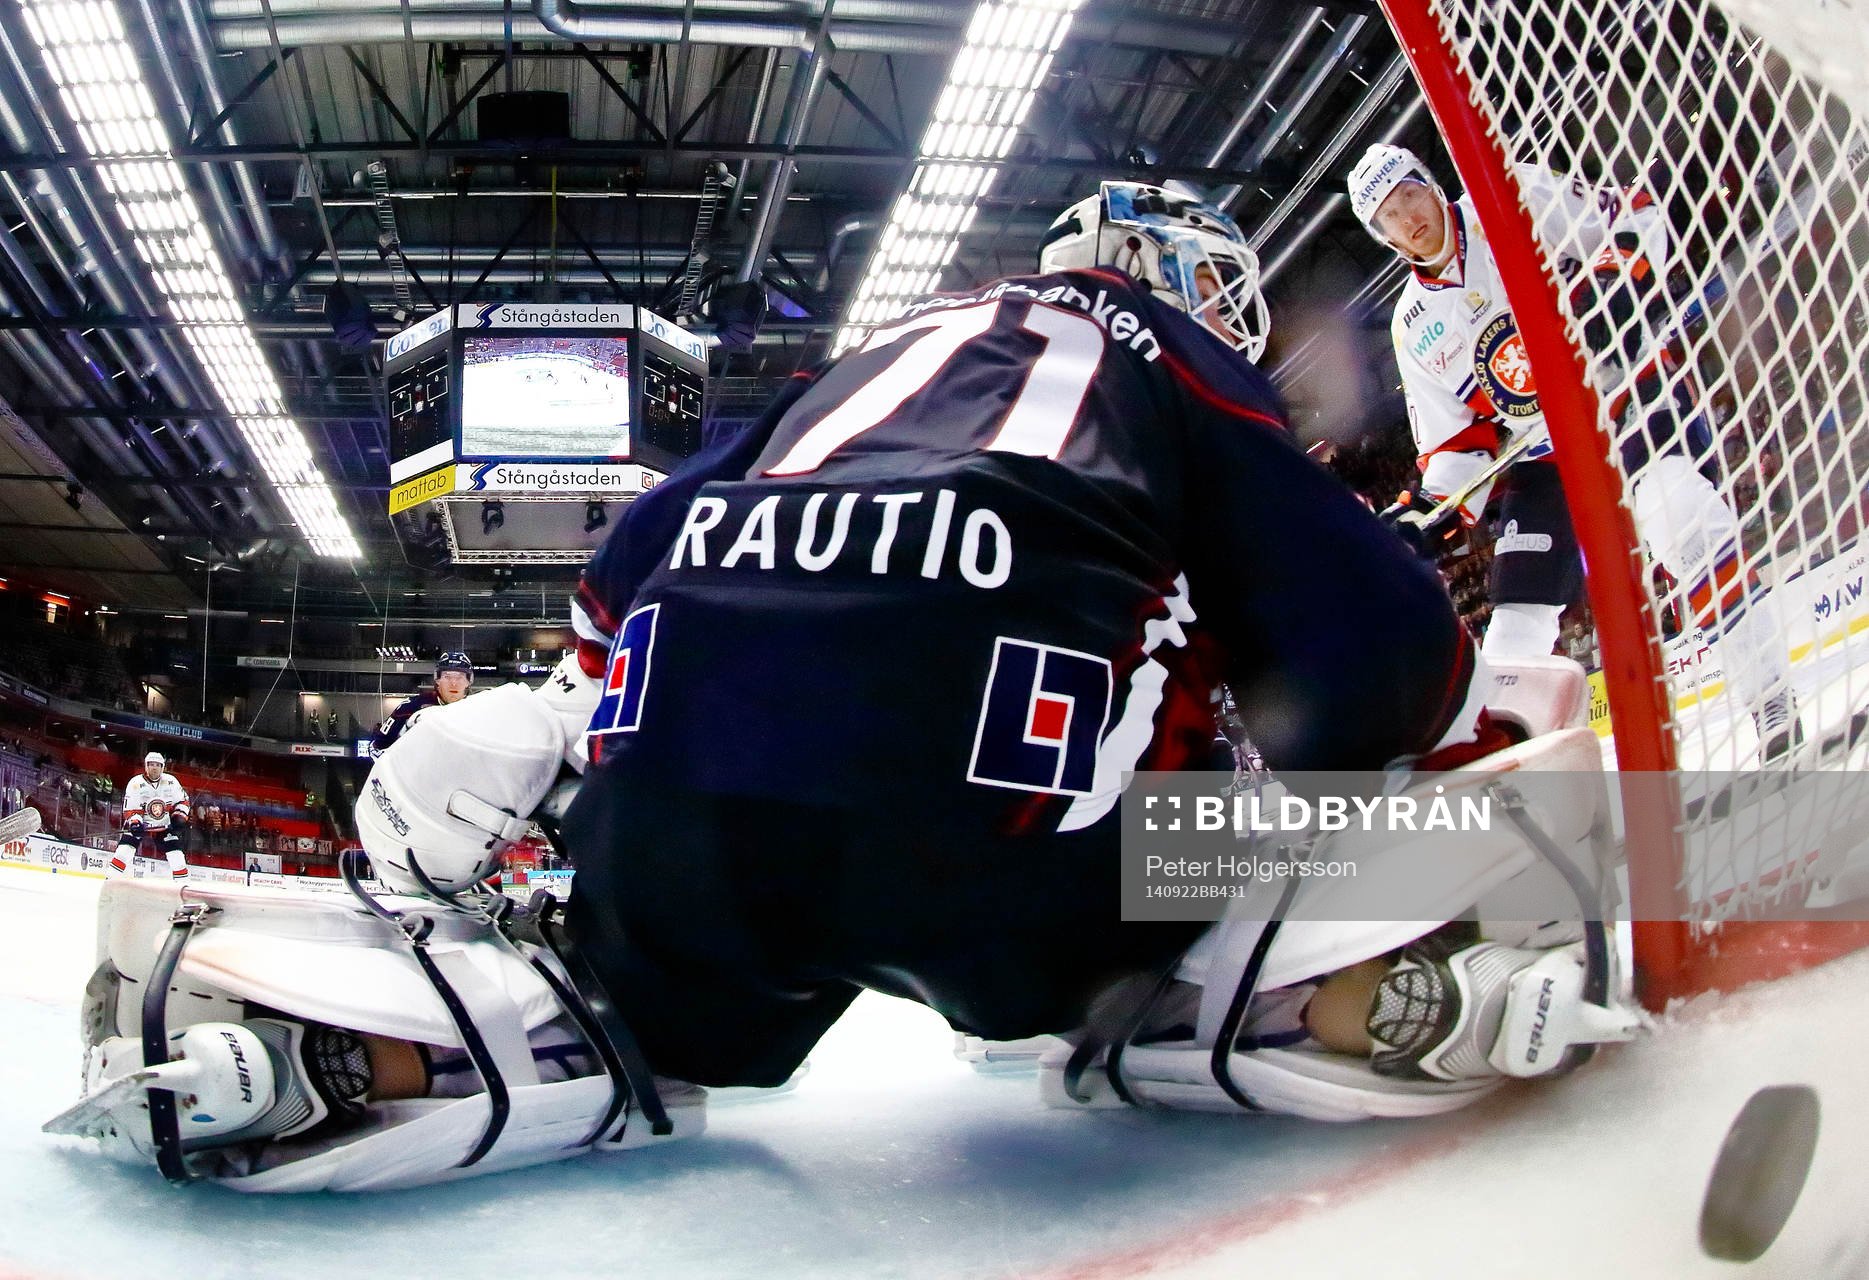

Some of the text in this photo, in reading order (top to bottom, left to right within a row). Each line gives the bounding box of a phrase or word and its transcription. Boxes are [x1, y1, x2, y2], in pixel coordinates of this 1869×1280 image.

[501, 306, 620, 327] Stångåstaden
[1414, 320, 1445, 357] wilo
[1477, 318, 1507, 358] LAKERS
[760, 298, 1107, 477] 71
[396, 472, 448, 504] mattab
[496, 468, 621, 489] Stångåstaden
[669, 489, 1012, 589] RAUTIO
[144, 720, 203, 740] DIAMOND CLUB
[88, 857, 104, 868] SAAB
[1526, 978, 1555, 1063] BAUER
[220, 1032, 252, 1103] BAUER
